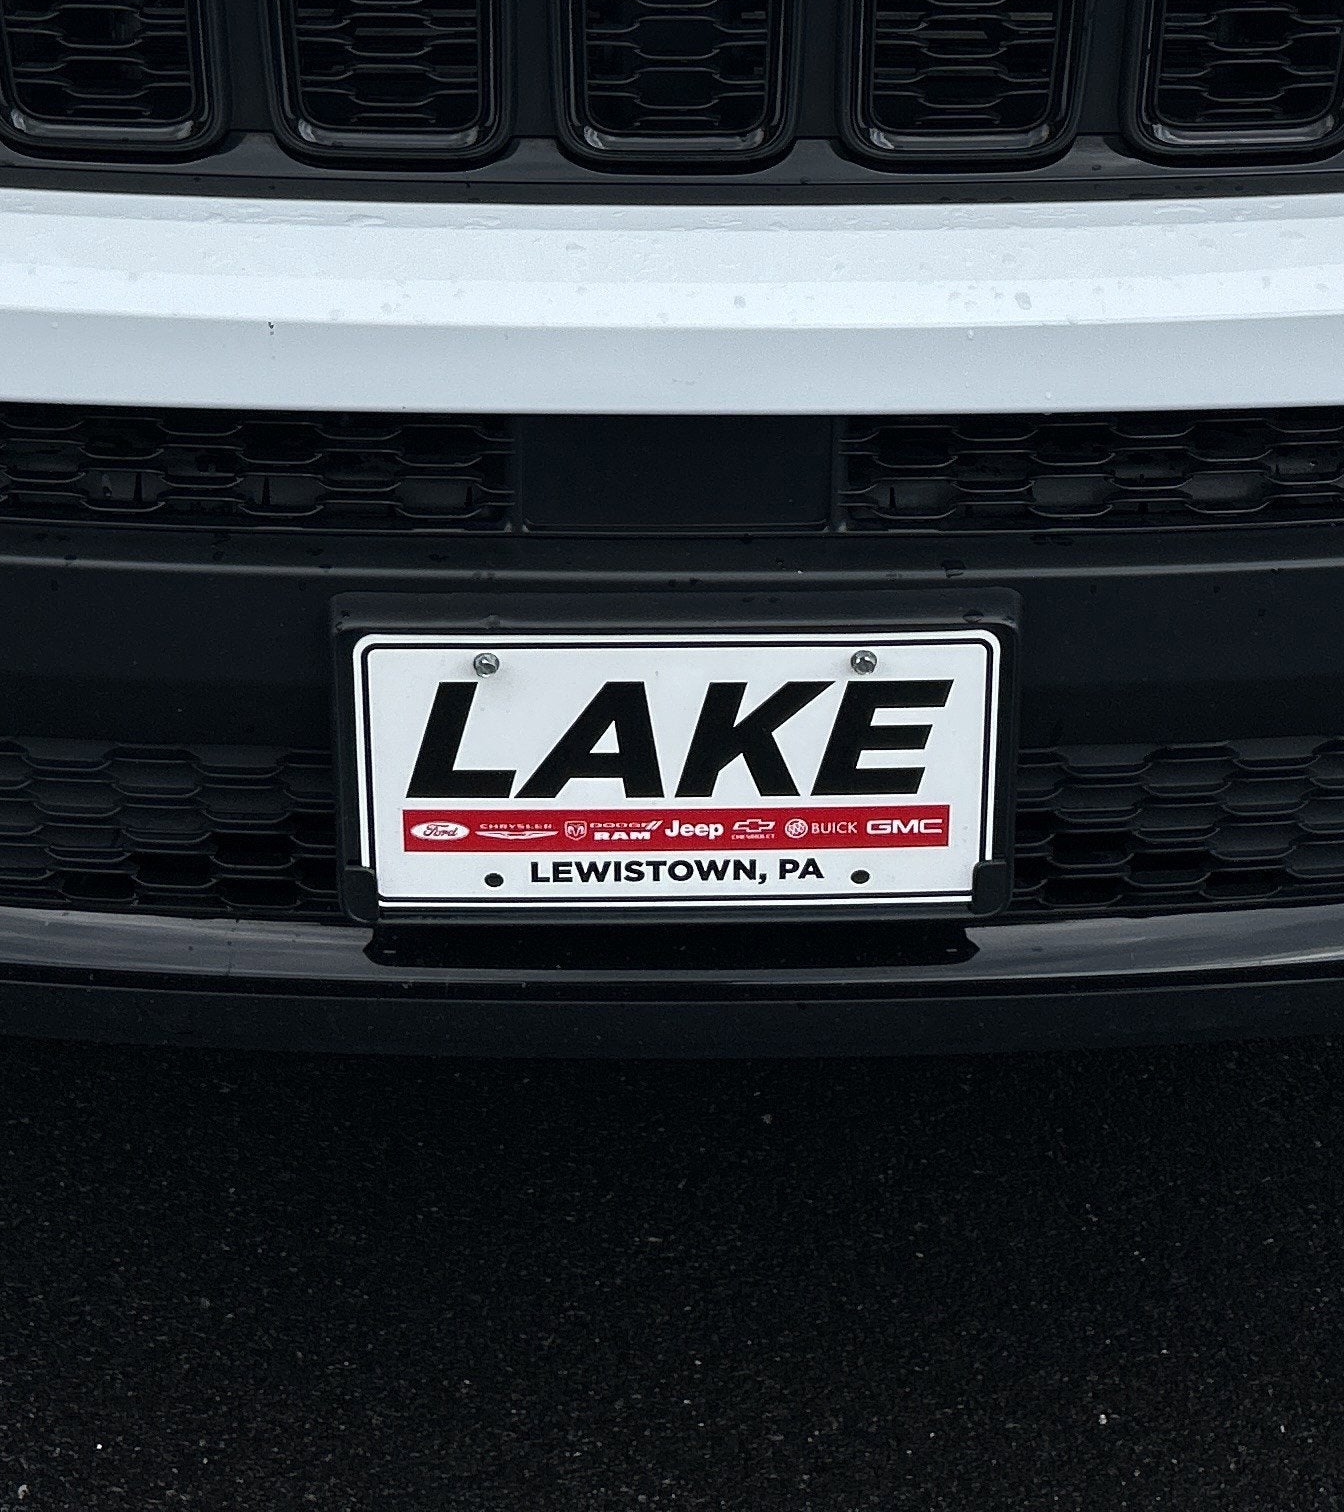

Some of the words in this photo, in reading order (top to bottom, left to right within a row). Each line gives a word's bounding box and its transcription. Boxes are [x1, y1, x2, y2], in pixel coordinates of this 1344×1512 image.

[406, 679, 954, 799] LAKE
[422, 824, 459, 838] Ford
[479, 822, 553, 830] CHRYSLER
[664, 819, 724, 839] Jeep
[811, 821, 858, 835] BUICK
[866, 819, 943, 835] GMC
[593, 831, 652, 841] RAM
[530, 859, 768, 885] LEWISTOWN,
[778, 858, 825, 880] PA
